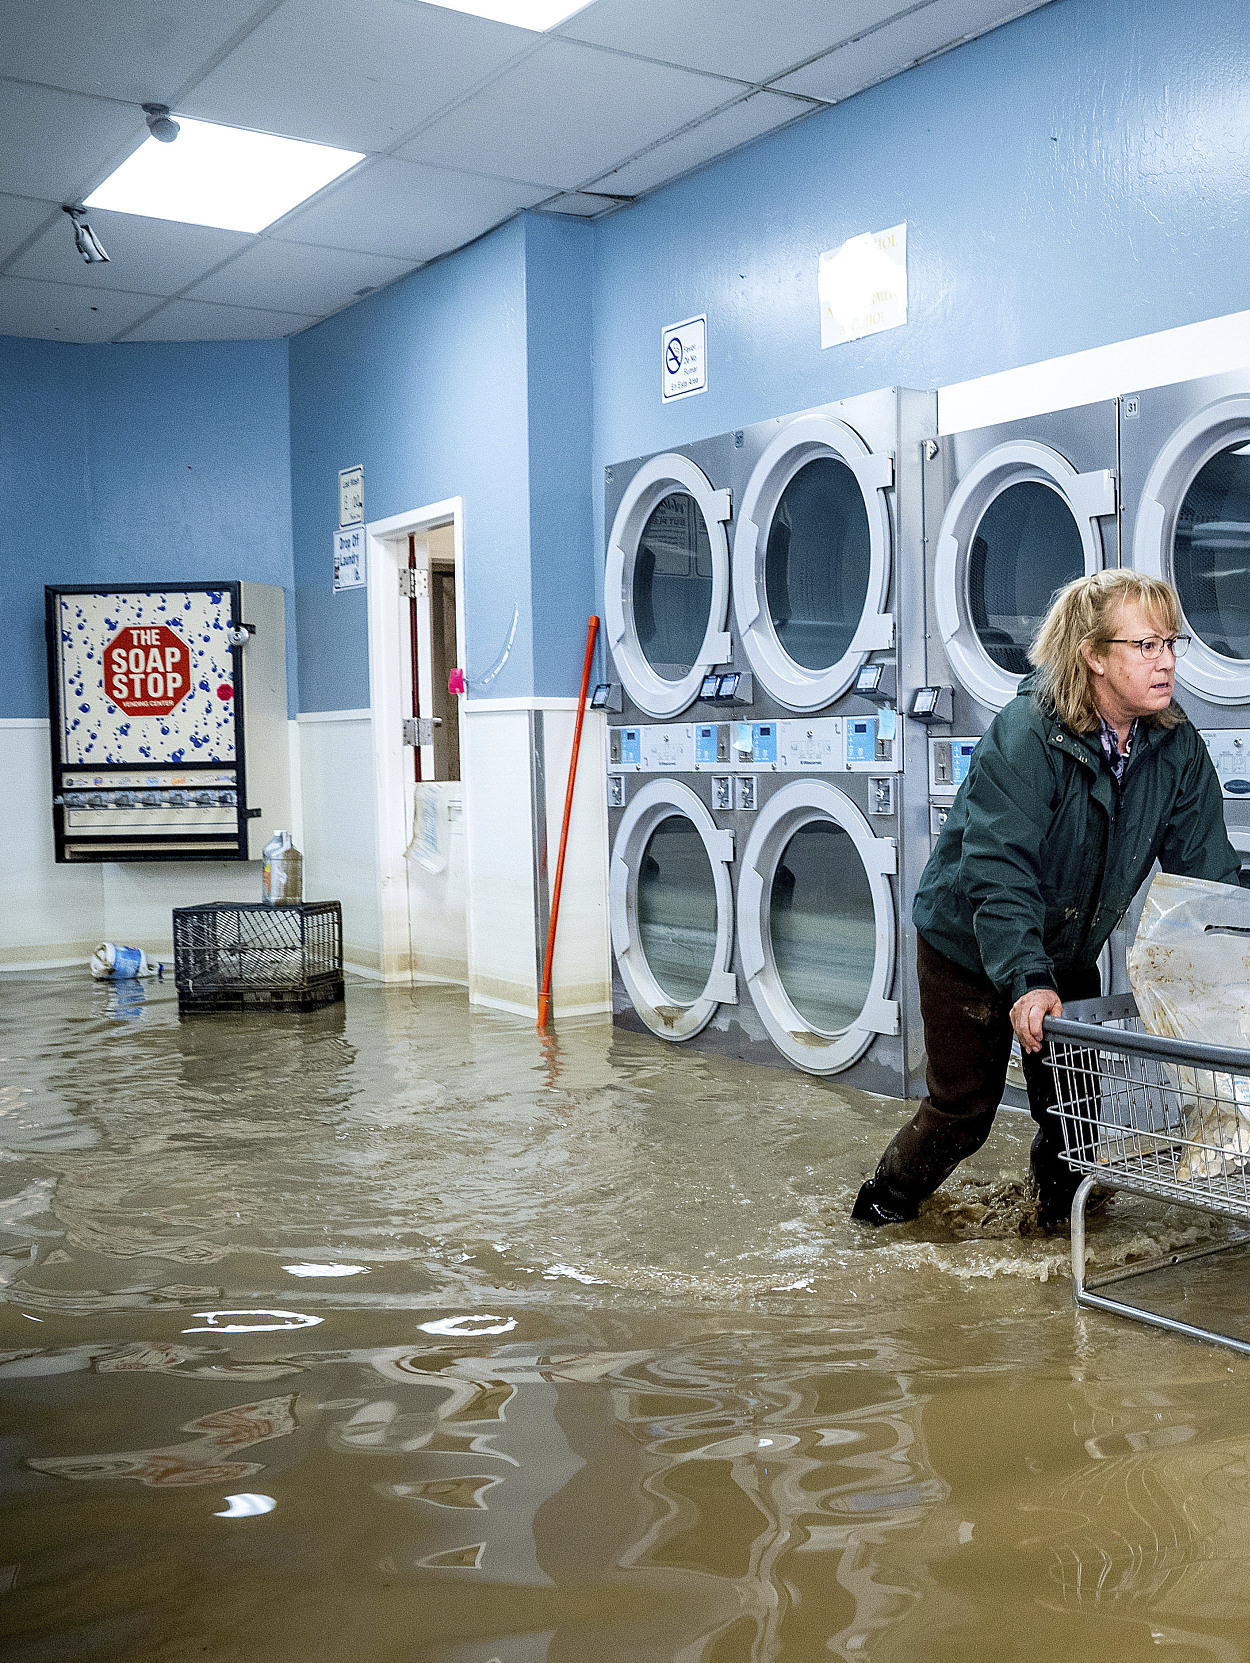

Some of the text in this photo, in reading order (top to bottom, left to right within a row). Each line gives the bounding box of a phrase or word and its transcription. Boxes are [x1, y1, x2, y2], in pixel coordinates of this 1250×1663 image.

[1127, 402, 1137, 413] 31
[129, 629, 161, 646] THE
[111, 647, 181, 674] SOAP
[112, 672, 183, 699] STOP
[122, 700, 149, 708] VENDING
